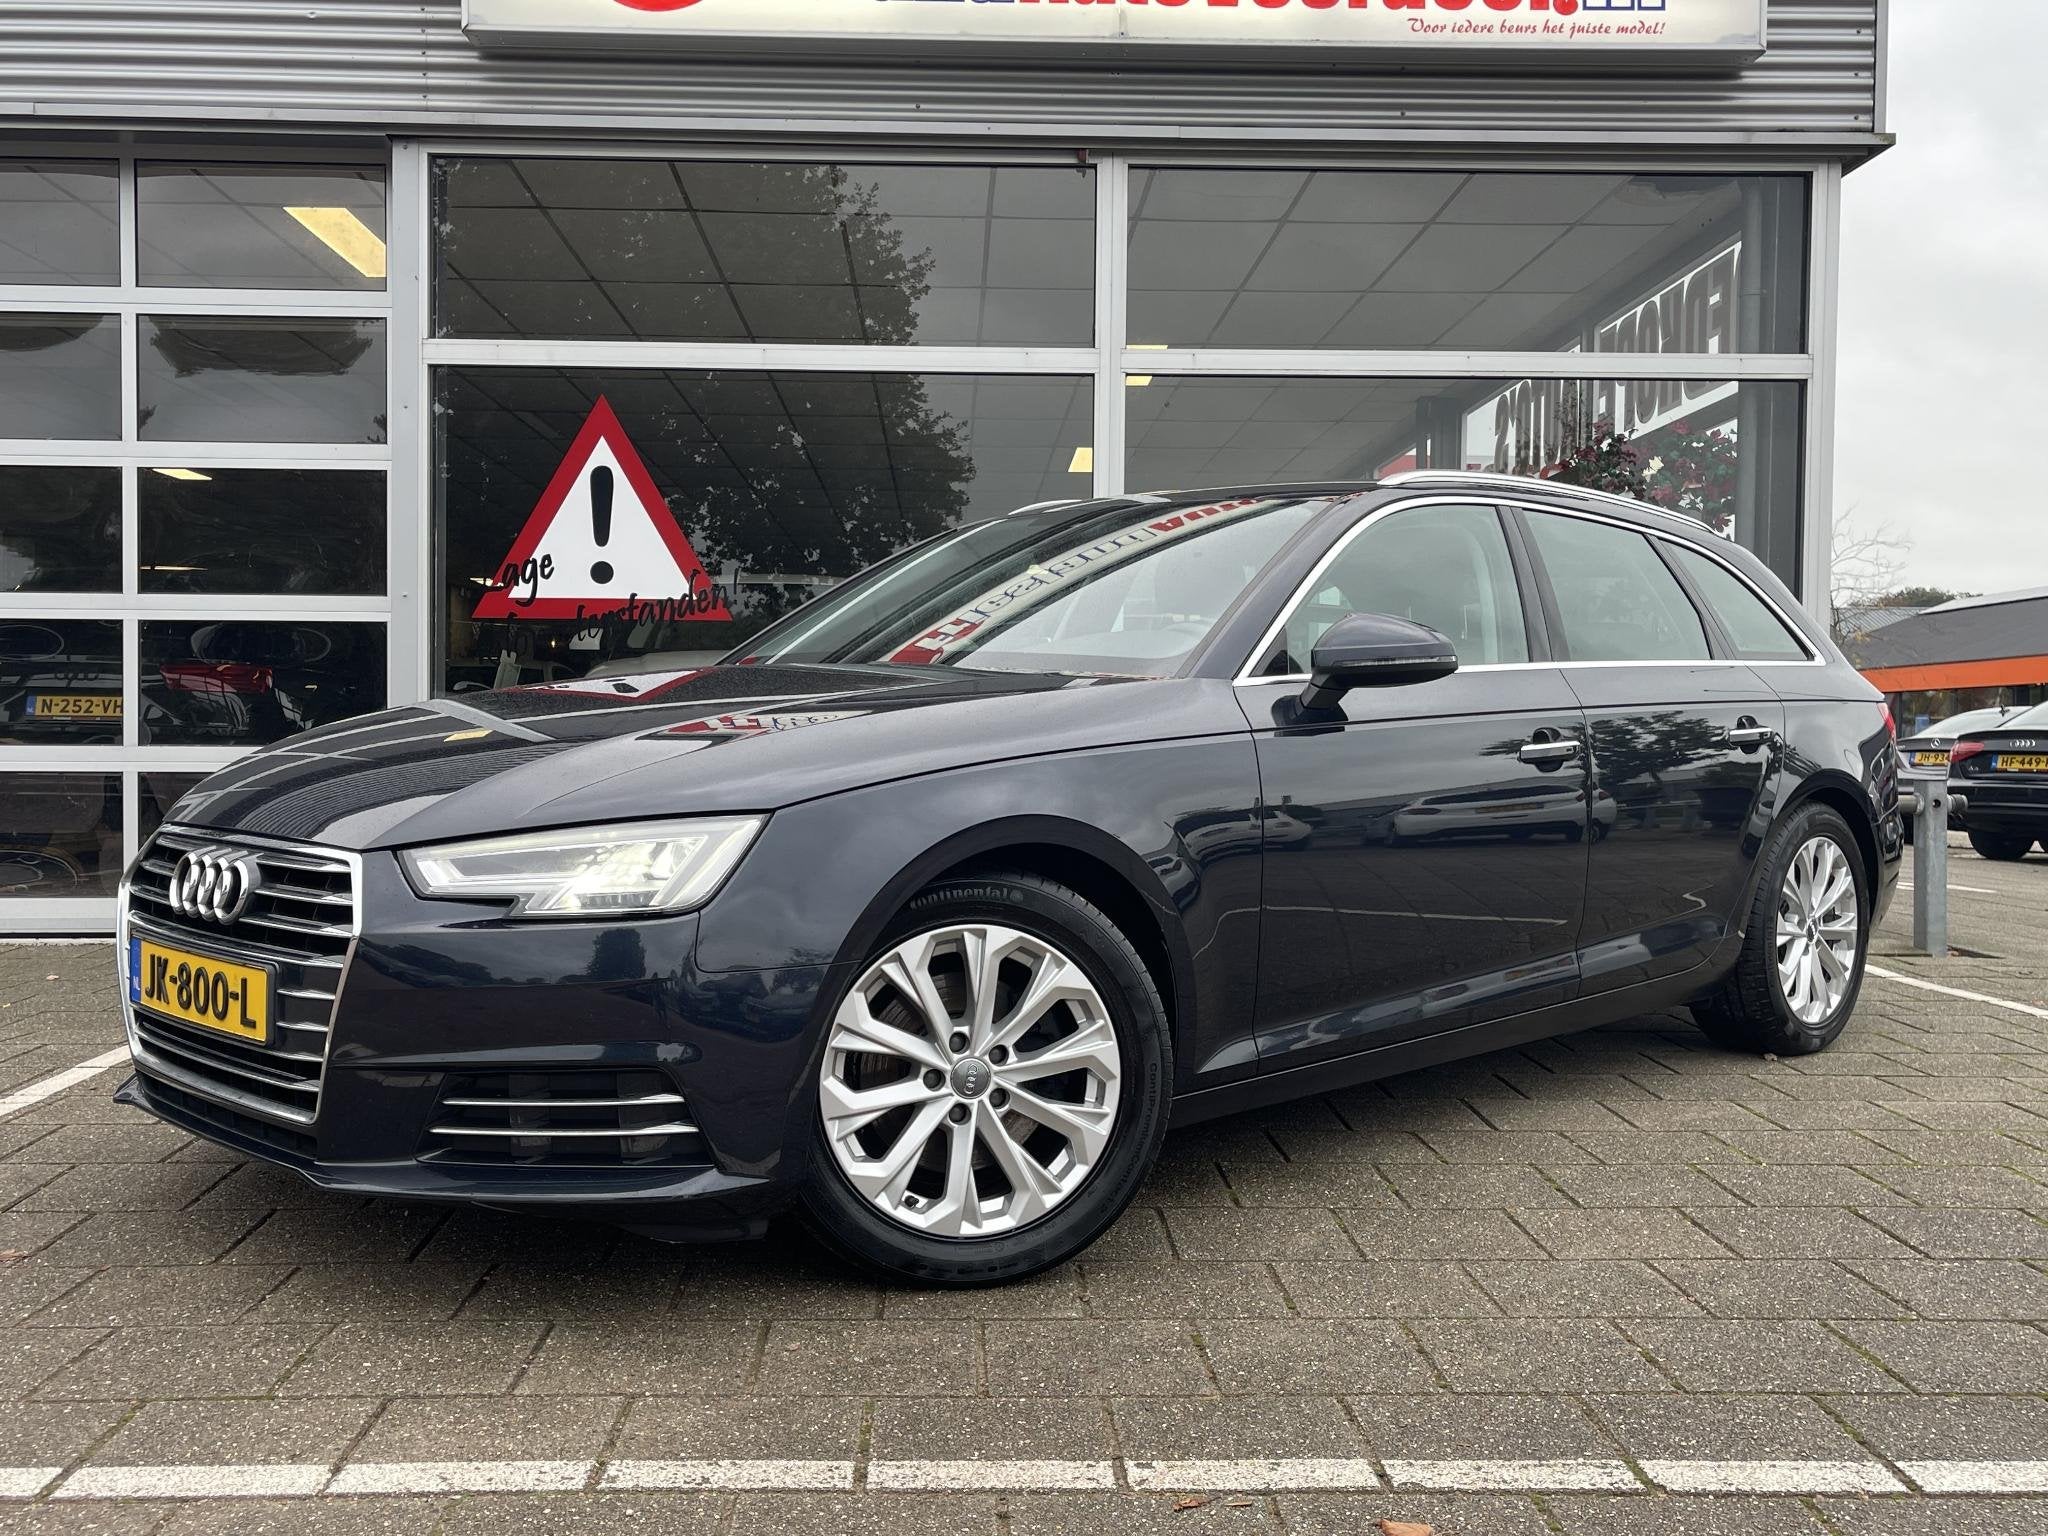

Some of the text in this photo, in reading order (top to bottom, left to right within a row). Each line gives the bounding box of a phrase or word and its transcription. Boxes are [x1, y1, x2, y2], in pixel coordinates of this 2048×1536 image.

[1407, 18, 1666, 39] Voor iedere beurs het juiste model!
[145, 953, 257, 1029] JK-800-L
